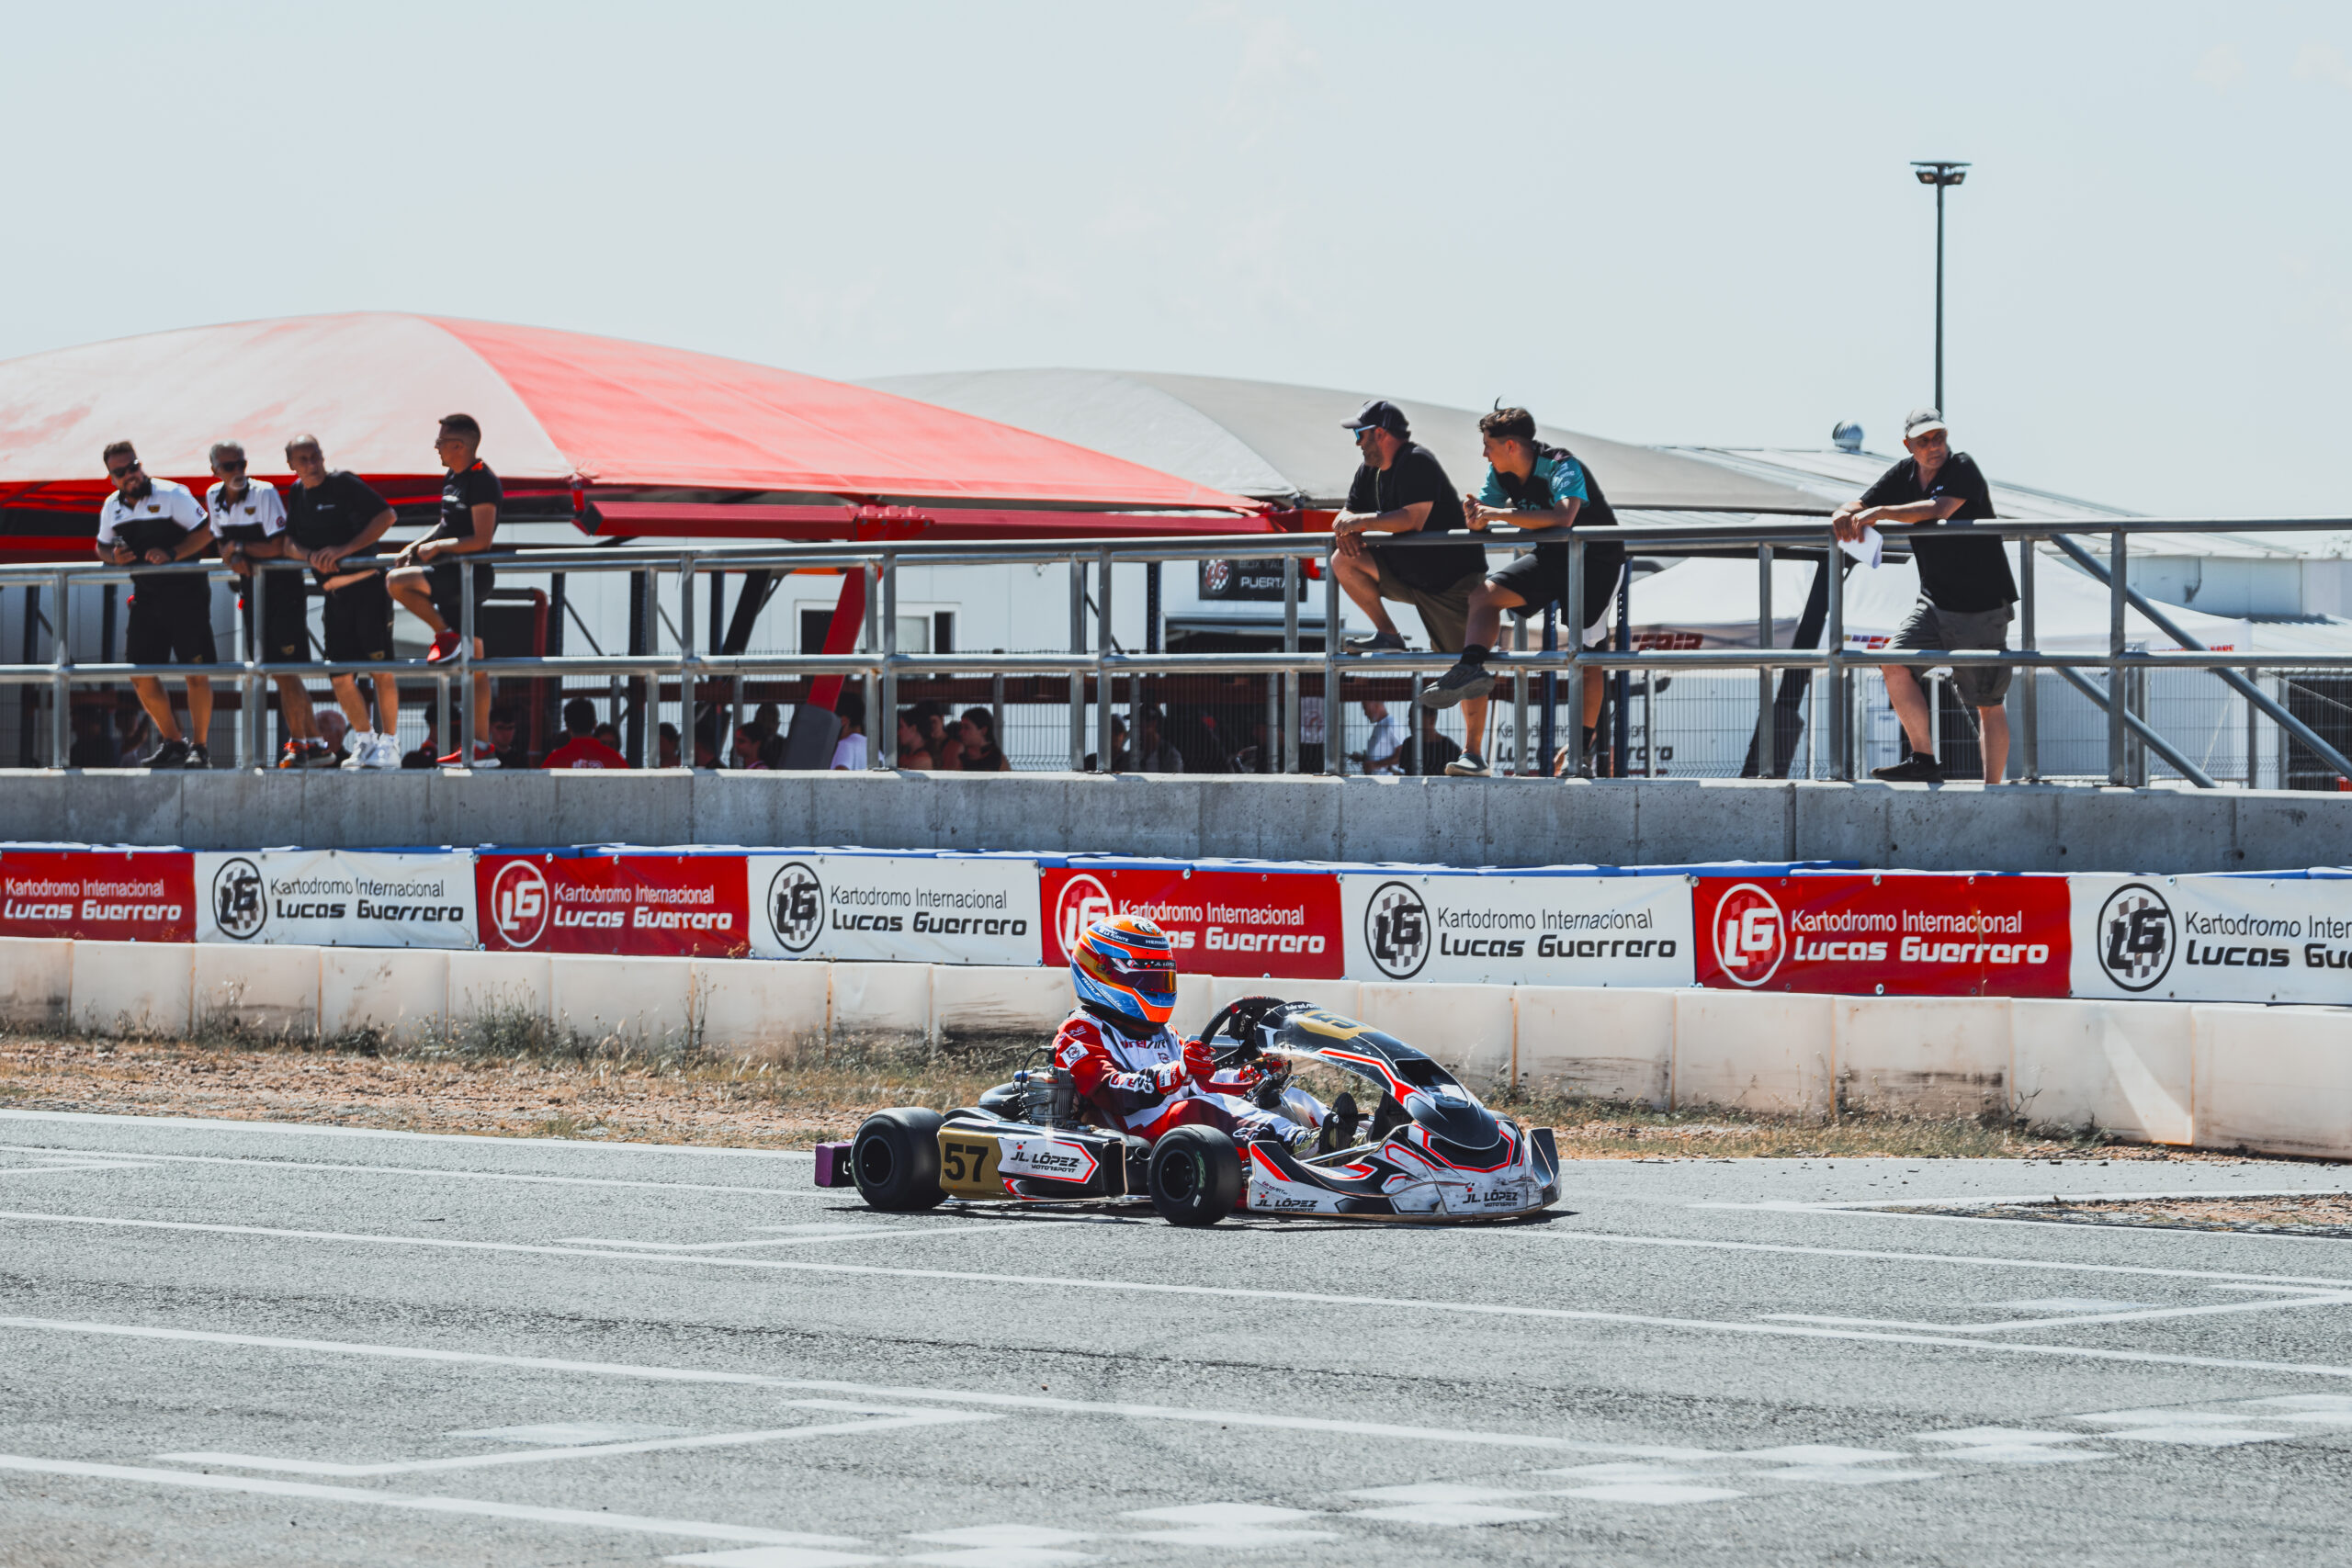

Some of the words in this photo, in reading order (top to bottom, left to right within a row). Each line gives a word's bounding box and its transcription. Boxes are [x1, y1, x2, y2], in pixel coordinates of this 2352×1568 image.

[6, 878, 79, 897] Kartodromo
[84, 879, 164, 897] Internacional
[271, 878, 353, 895] Kartodromo
[356, 877, 444, 897] Internacional
[554, 883, 631, 903] Kartodromo
[636, 885, 714, 904] Internacional
[831, 886, 910, 906] Kartodromo
[917, 888, 1006, 908] Internacional
[5, 899, 73, 919] Lucas
[82, 900, 181, 920] Guerrero
[277, 899, 345, 918] Lucas
[357, 899, 463, 921] Guerrero
[554, 905, 625, 928] Lucas
[633, 907, 732, 930] Guerrero
[1207, 902, 1304, 925] Internacional
[1439, 908, 1535, 929] Kartodromo
[1543, 908, 1652, 930] Internacional
[832, 909, 902, 931] Lucas
[913, 912, 1026, 935] Guerrero
[1792, 909, 1896, 931] Kartodromo
[1903, 909, 2021, 934] Internacional
[2186, 912, 2301, 937] Kartodromo
[1205, 927, 1325, 953] Guerrero
[1441, 933, 1525, 957] Lucas
[1538, 935, 1676, 957] Guerrero
[1794, 936, 1887, 961] Lucas
[1900, 937, 2049, 964] Guerrero
[2187, 941, 2290, 966] Lucas
[944, 1143, 989, 1182] 57
[1011, 1152, 1029, 1163] JL.
[1032, 1152, 1080, 1168] LÓPEZ
[1463, 1194, 1481, 1204] JL.
[1484, 1189, 1518, 1201] LÓPEZ
